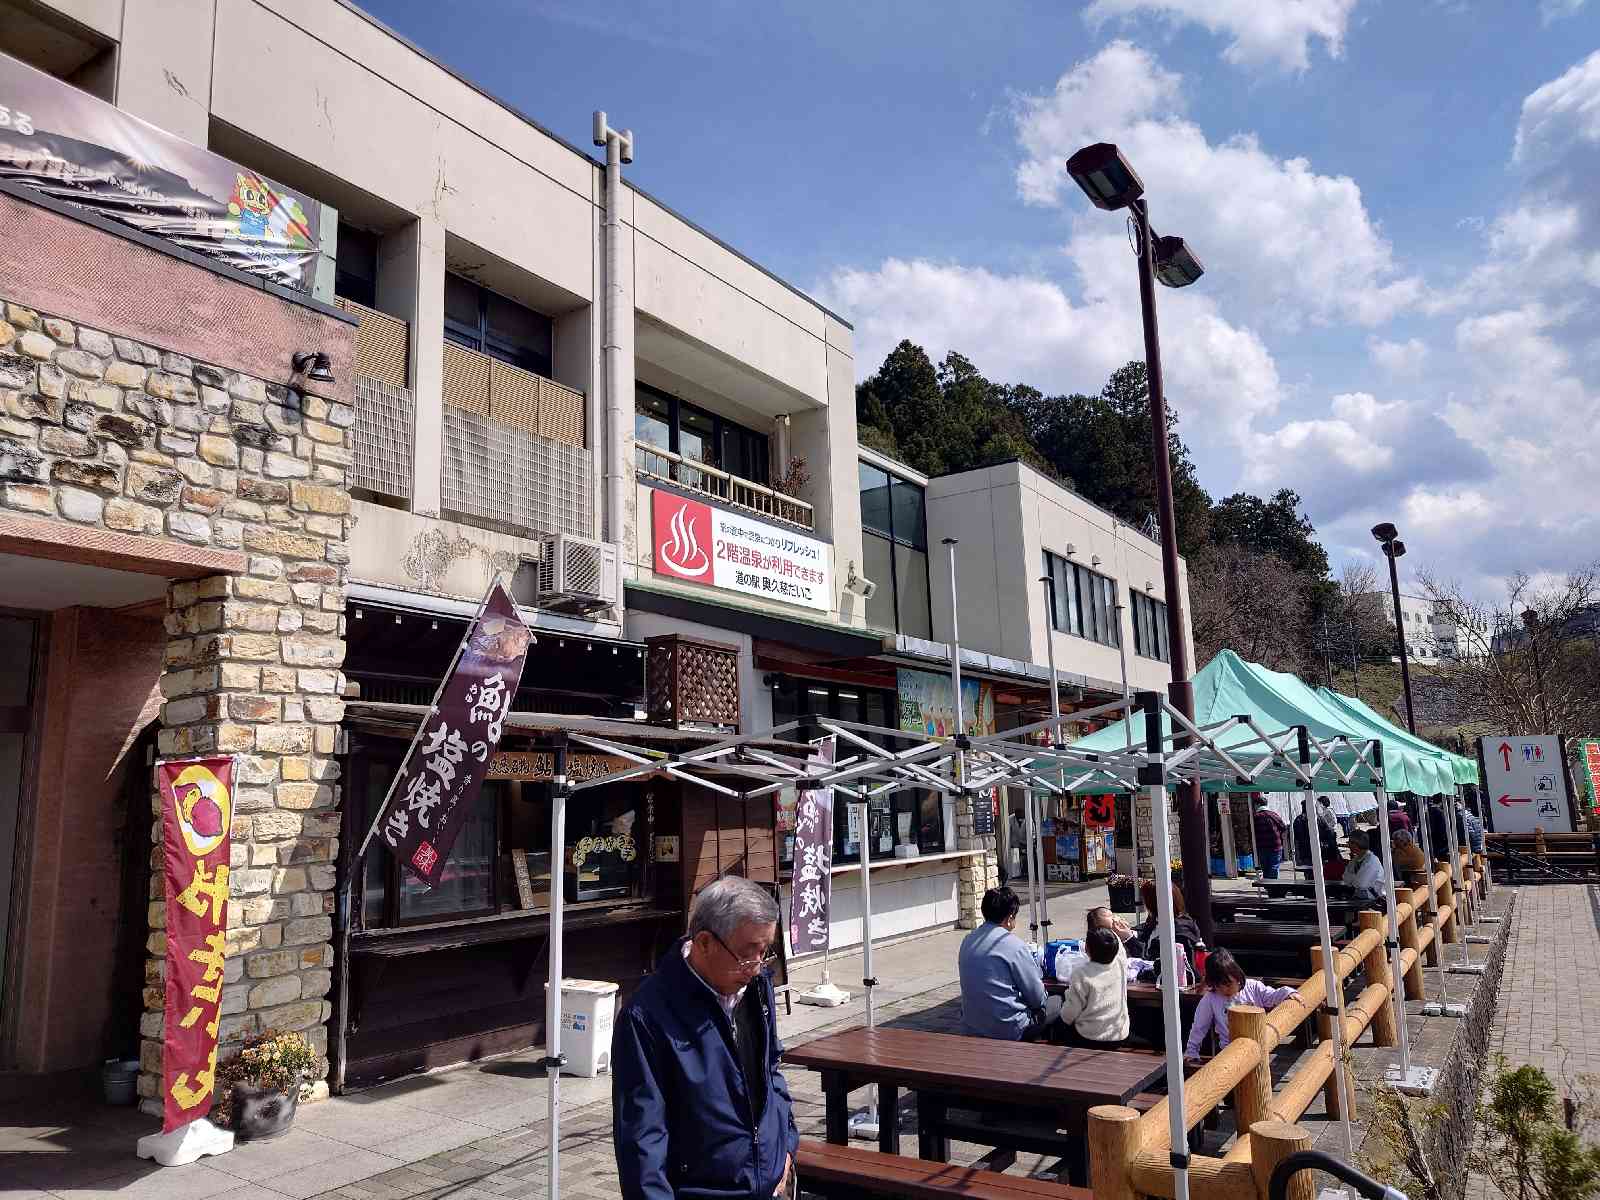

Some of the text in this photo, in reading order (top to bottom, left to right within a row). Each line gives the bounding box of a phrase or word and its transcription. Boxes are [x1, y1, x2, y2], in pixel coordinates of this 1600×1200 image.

[716, 539, 825, 585] 2階温泉が利用できます
[735, 569, 760, 589] 道の駅
